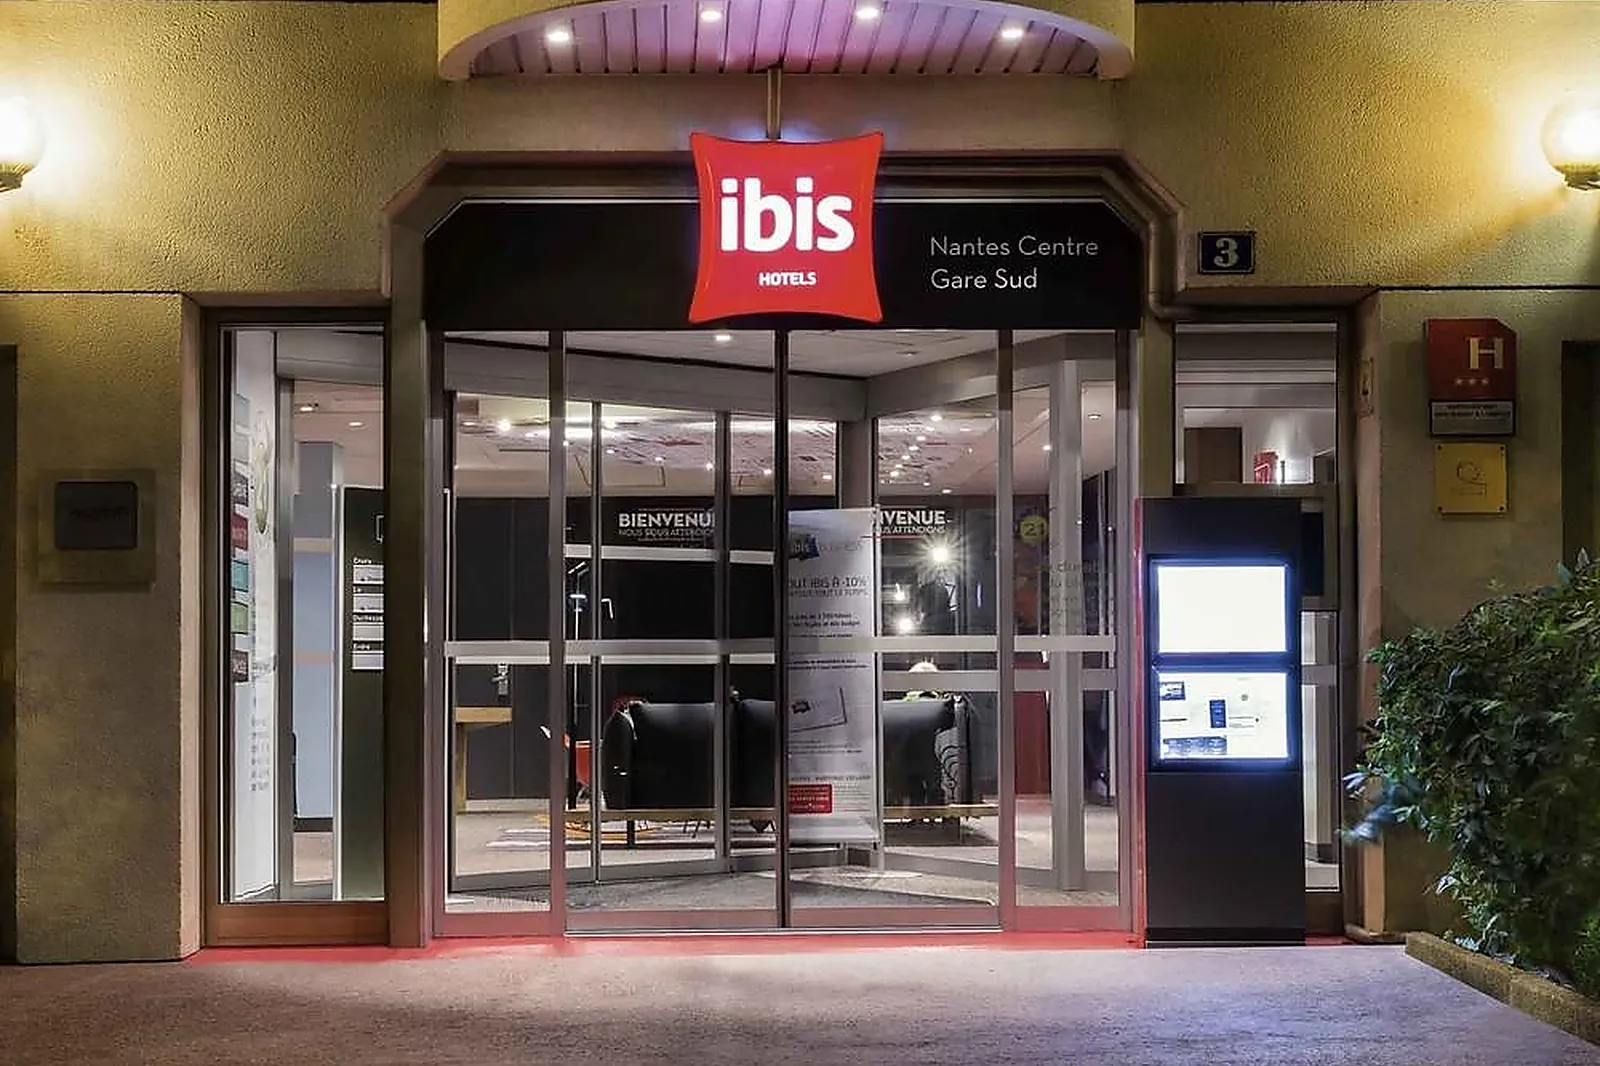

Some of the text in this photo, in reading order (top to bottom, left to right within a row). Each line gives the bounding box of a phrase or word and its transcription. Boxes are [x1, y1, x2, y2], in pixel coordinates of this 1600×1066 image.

[721, 177, 855, 252] ibis
[930, 236, 1099, 257] Nantes Centre
[1213, 238, 1240, 268] 3
[758, 271, 818, 287] HOTELS
[930, 267, 1038, 290] Gare Sud
[1466, 336, 1505, 369] H
